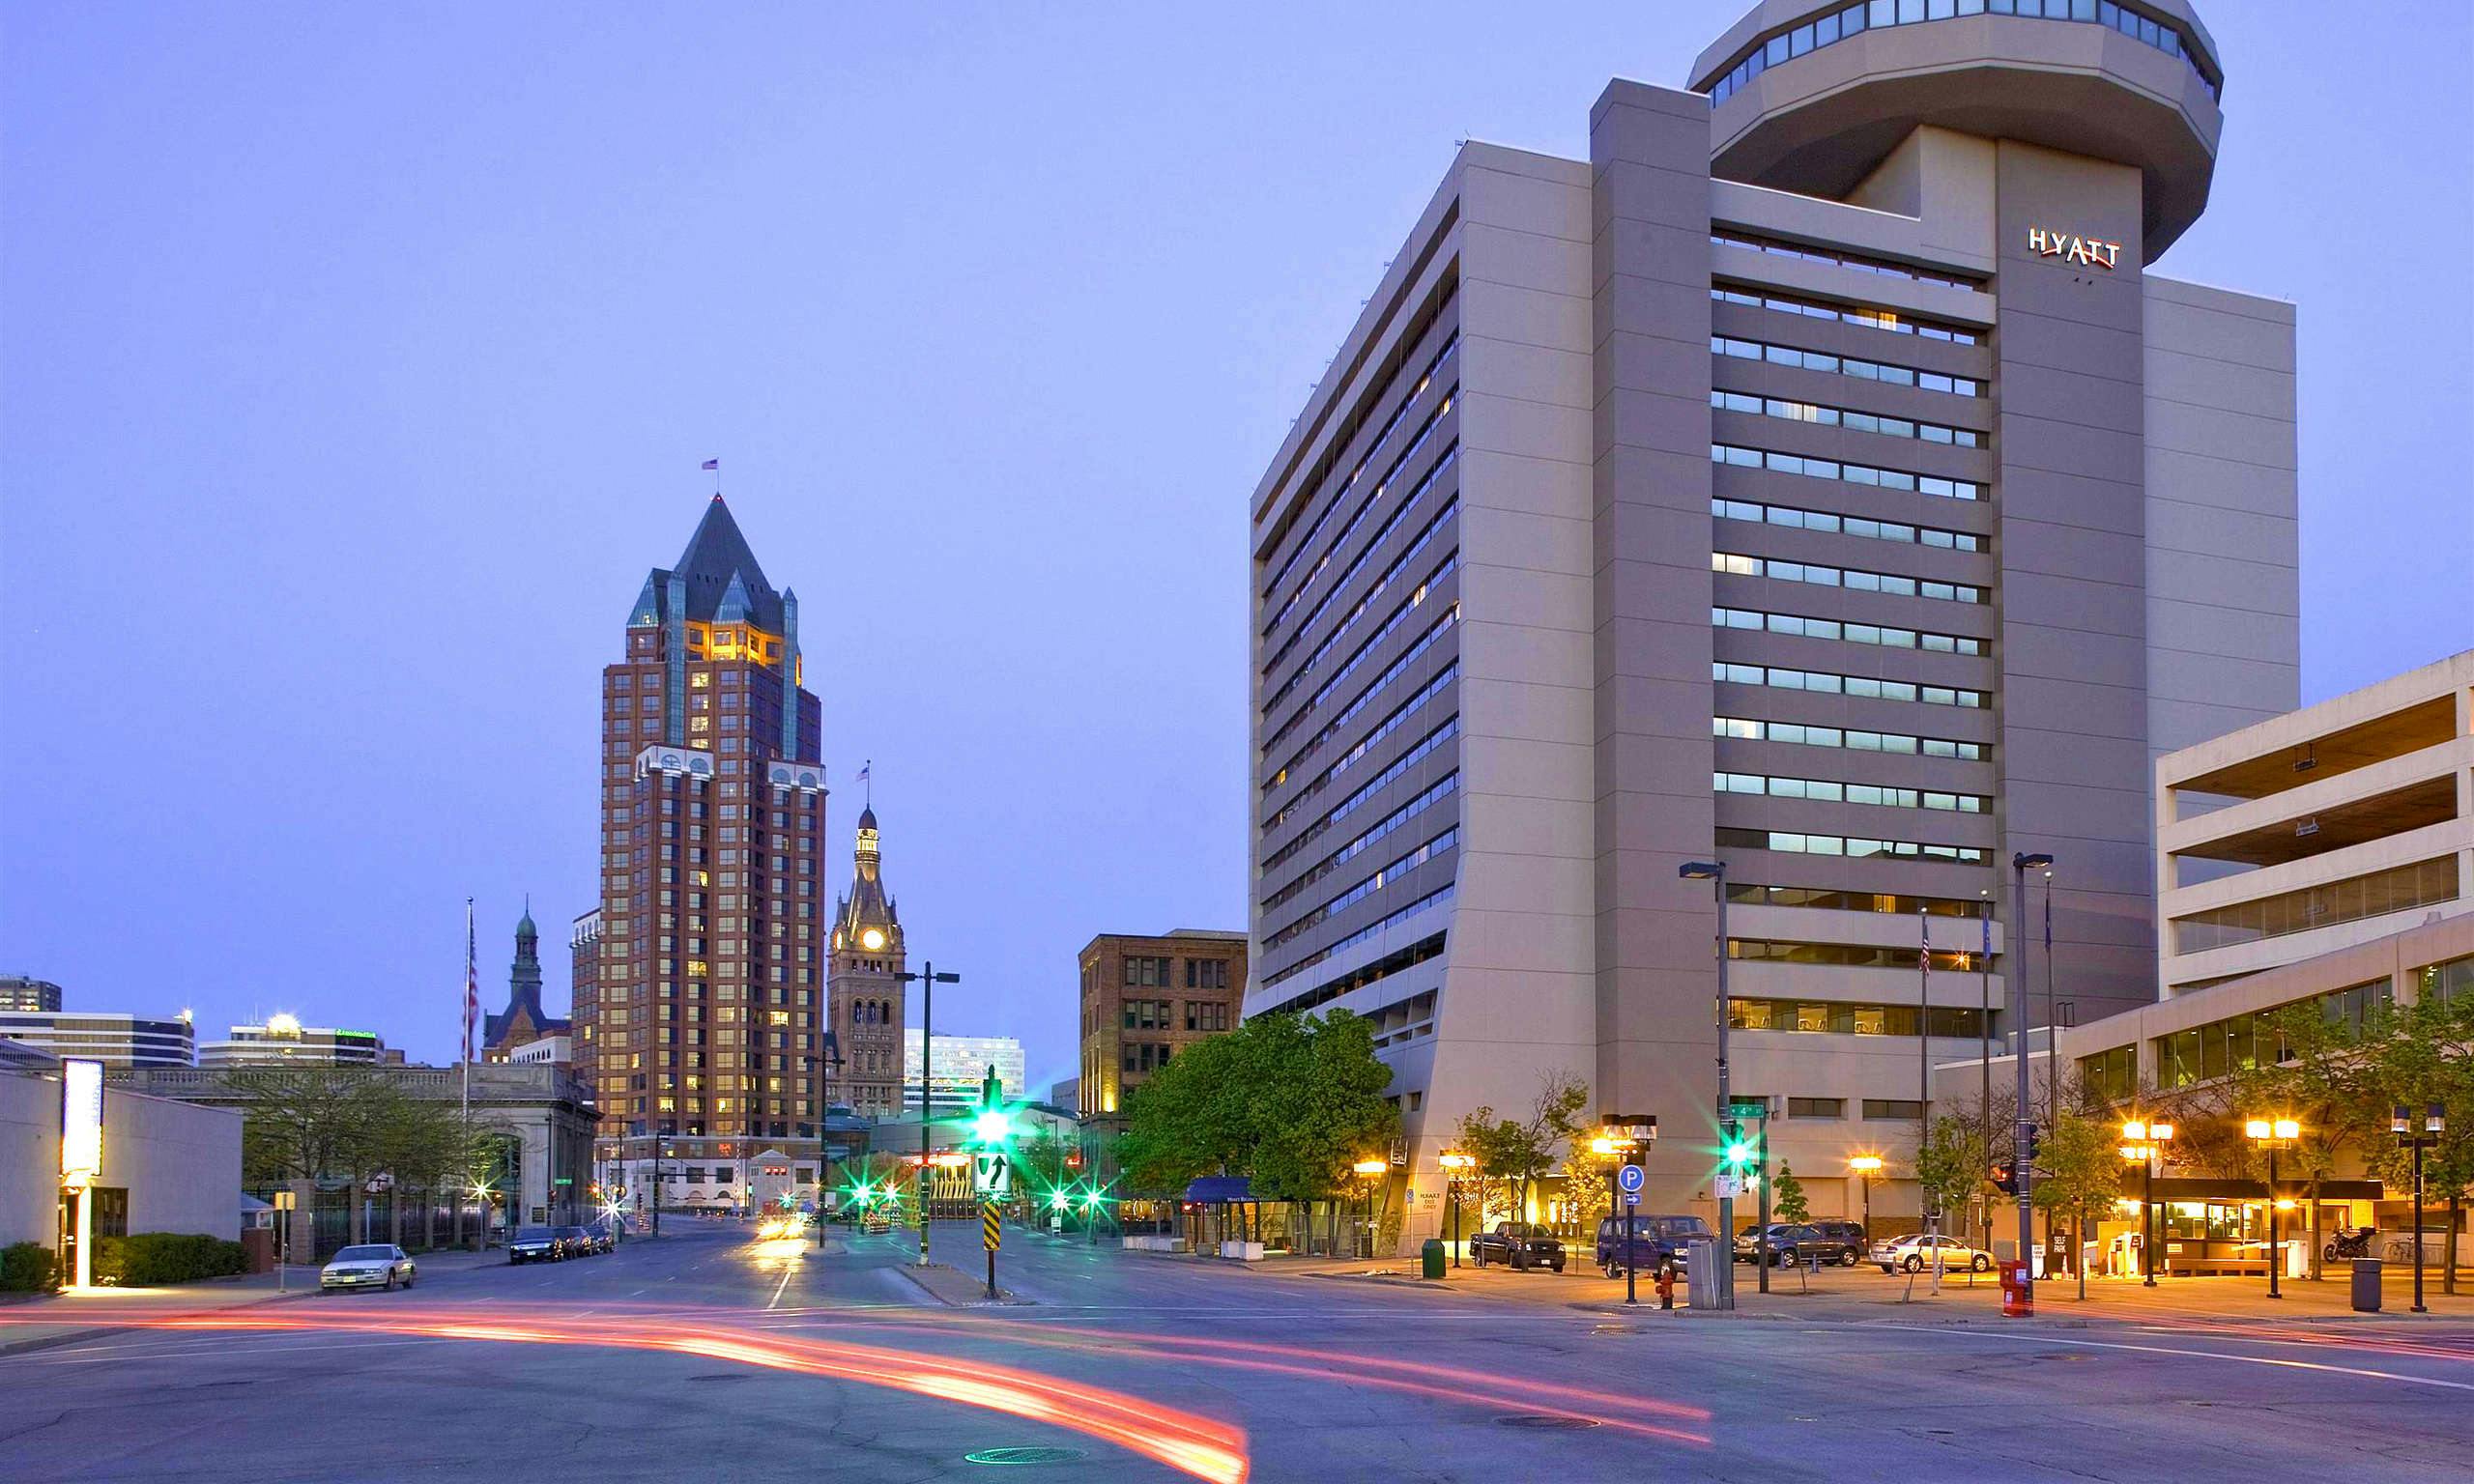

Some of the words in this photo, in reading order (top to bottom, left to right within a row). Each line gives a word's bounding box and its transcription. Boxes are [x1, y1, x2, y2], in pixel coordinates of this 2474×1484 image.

[2028, 228, 2120, 266] HYATT
[1626, 1171, 1638, 1186] P
[2054, 1236, 2066, 1244] SELF
[2054, 1244, 2066, 1253] PARK
